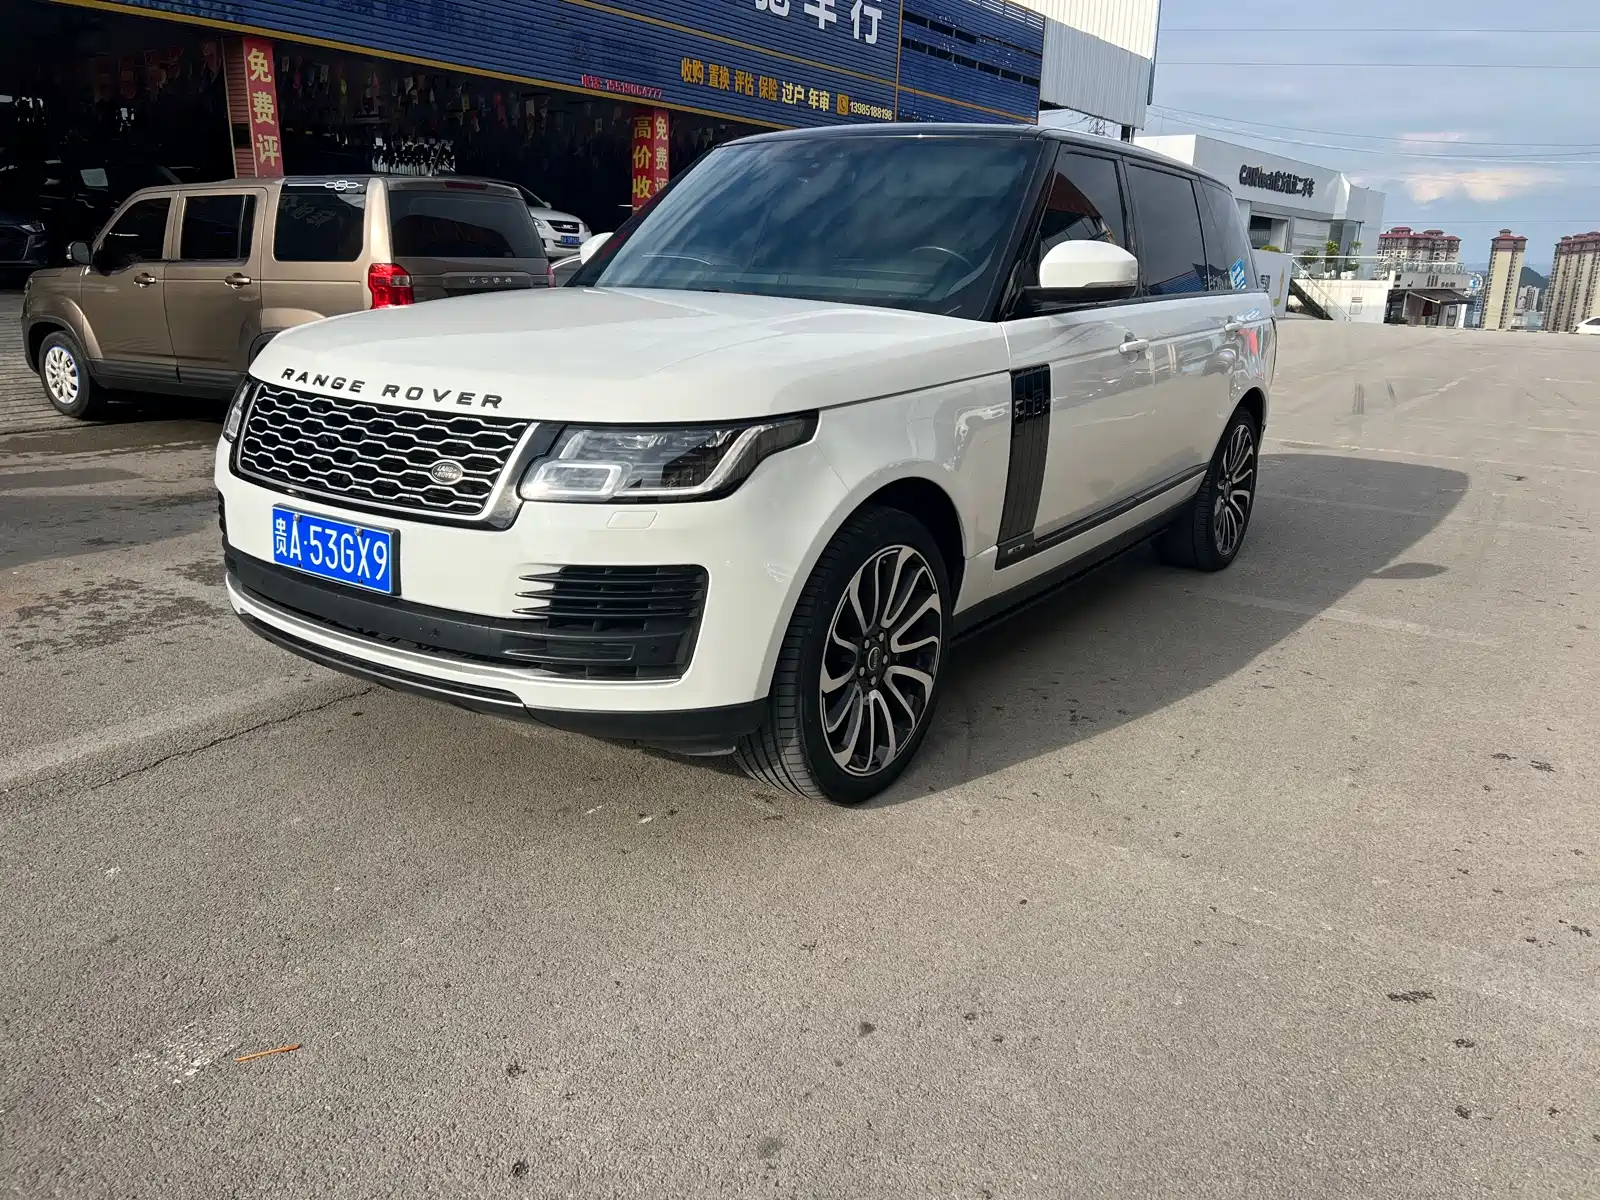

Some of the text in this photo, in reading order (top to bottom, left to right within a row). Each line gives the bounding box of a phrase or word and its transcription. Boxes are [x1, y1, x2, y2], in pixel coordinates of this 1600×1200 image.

[681, 57, 830, 112] 收购 置换 评估 保险 过户 年审
[632, 116, 652, 210] 高价收
[281, 367, 503, 409] RANGE ROVER
[437, 471, 457, 479] ROVER
